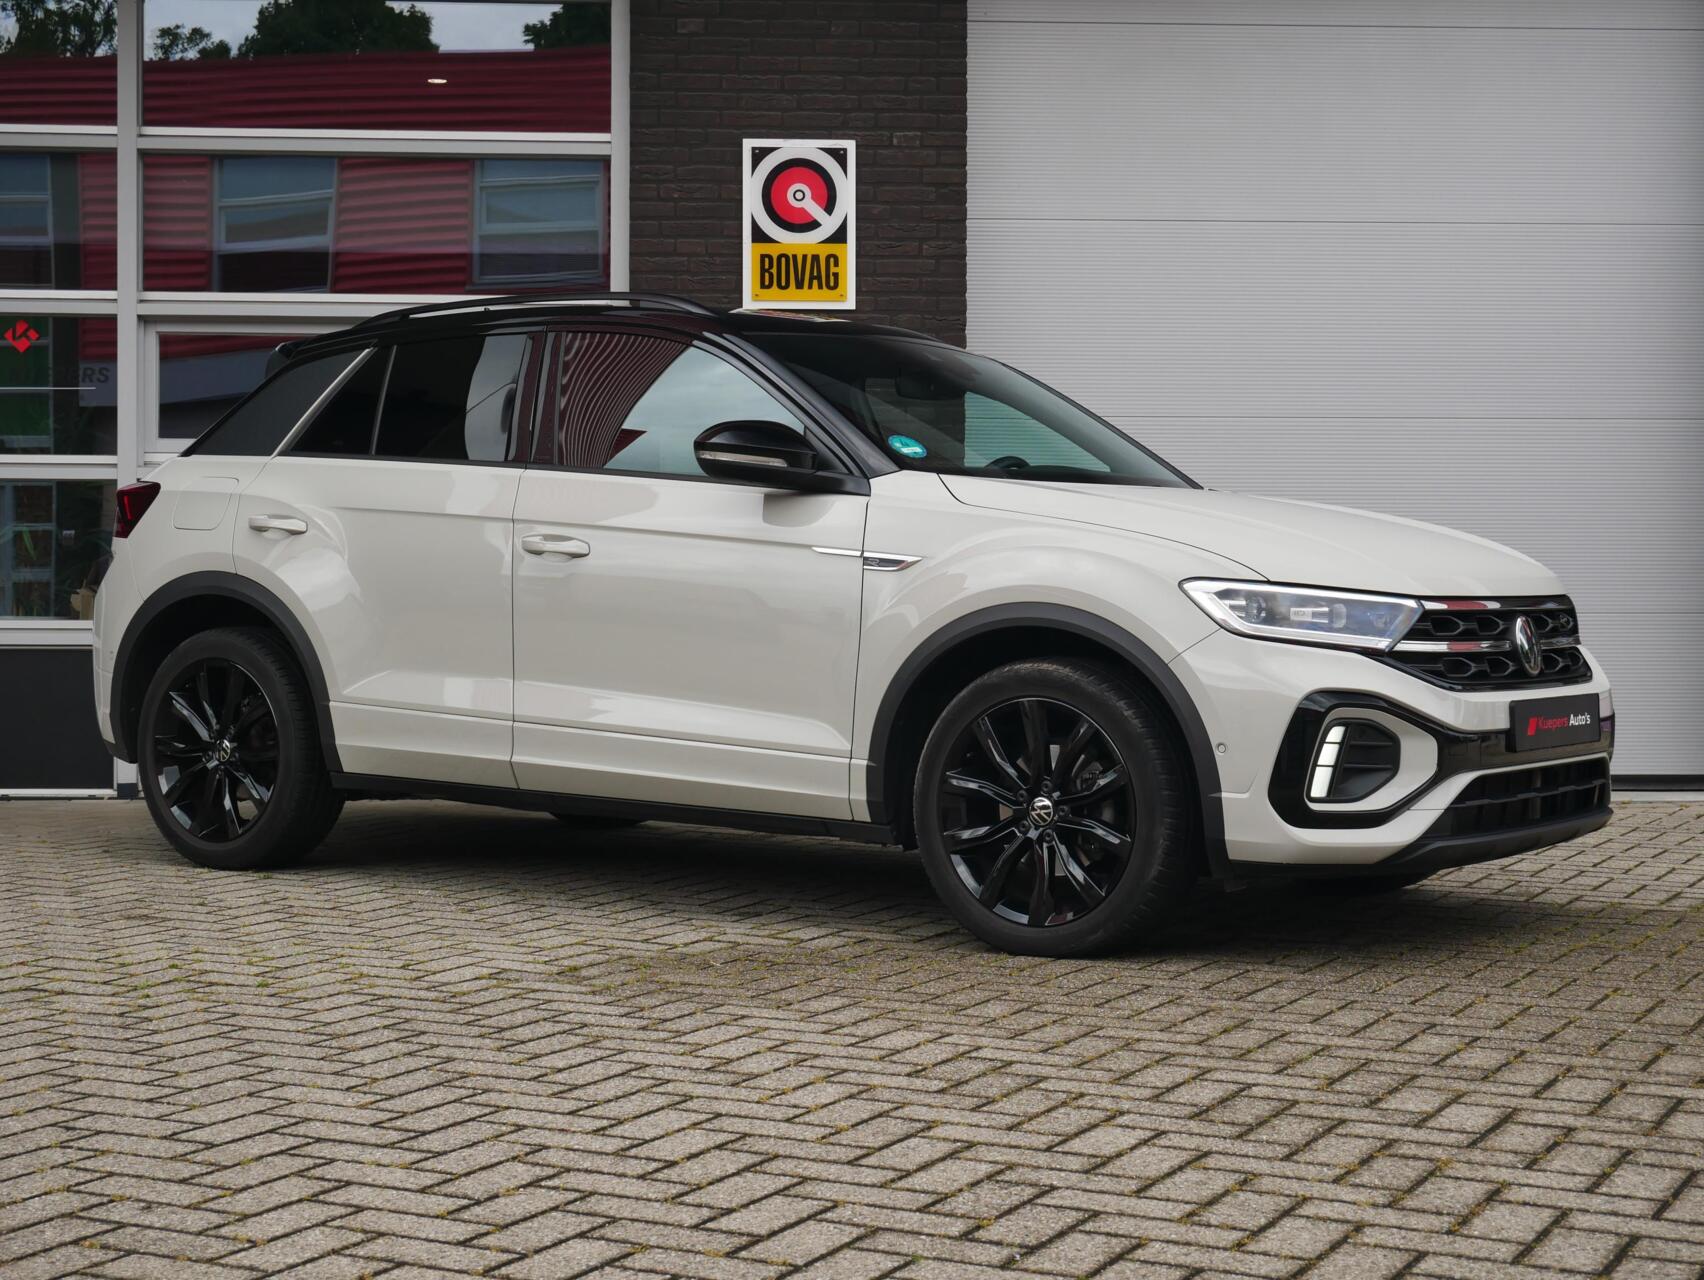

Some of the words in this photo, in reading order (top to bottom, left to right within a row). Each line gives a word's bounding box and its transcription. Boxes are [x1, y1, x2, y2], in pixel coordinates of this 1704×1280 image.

[759, 253, 840, 291] BOVAG
[1538, 715, 1568, 731] Kuepers
[1569, 712, 1591, 727] Auto's
